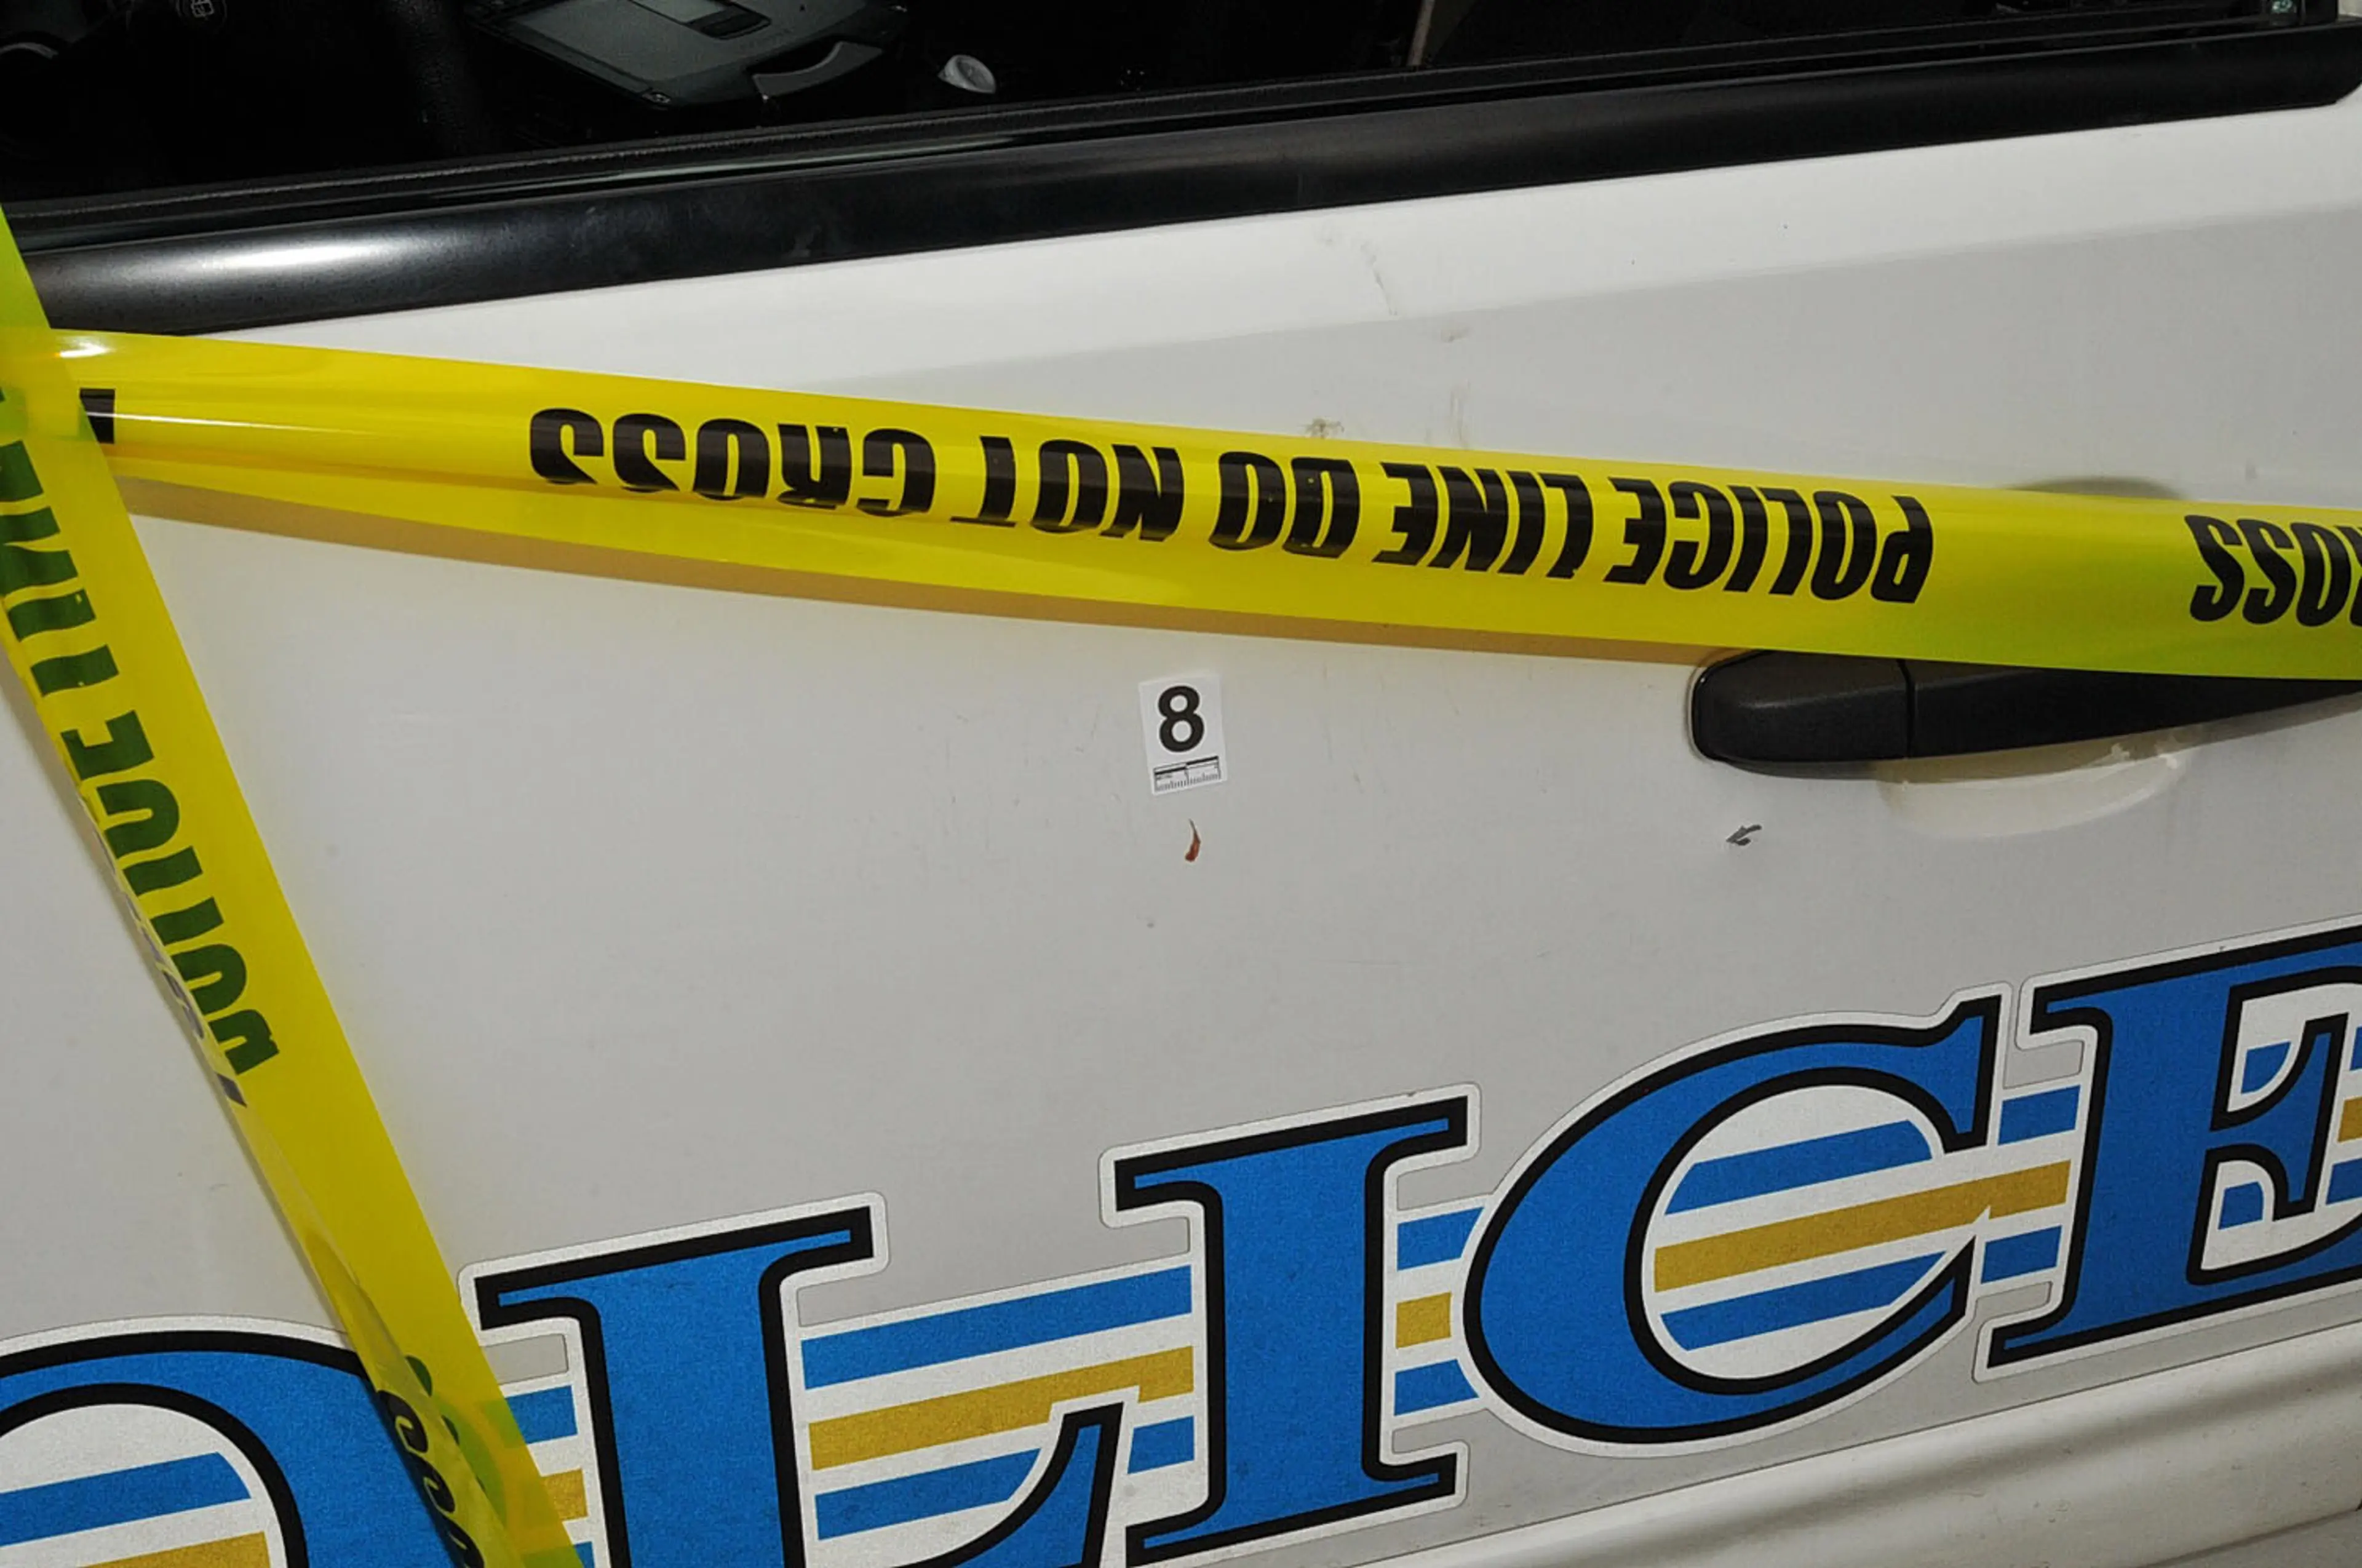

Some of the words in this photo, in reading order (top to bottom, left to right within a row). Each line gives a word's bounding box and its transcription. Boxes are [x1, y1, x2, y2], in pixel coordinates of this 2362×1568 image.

[530, 407, 936, 517] CROSS
[950, 435, 1185, 542] NOT
[1208, 451, 1361, 559] DO
[1372, 462, 1594, 579] LINE
[1603, 476, 1933, 603] POLICE
[1158, 685, 1205, 753] 8
